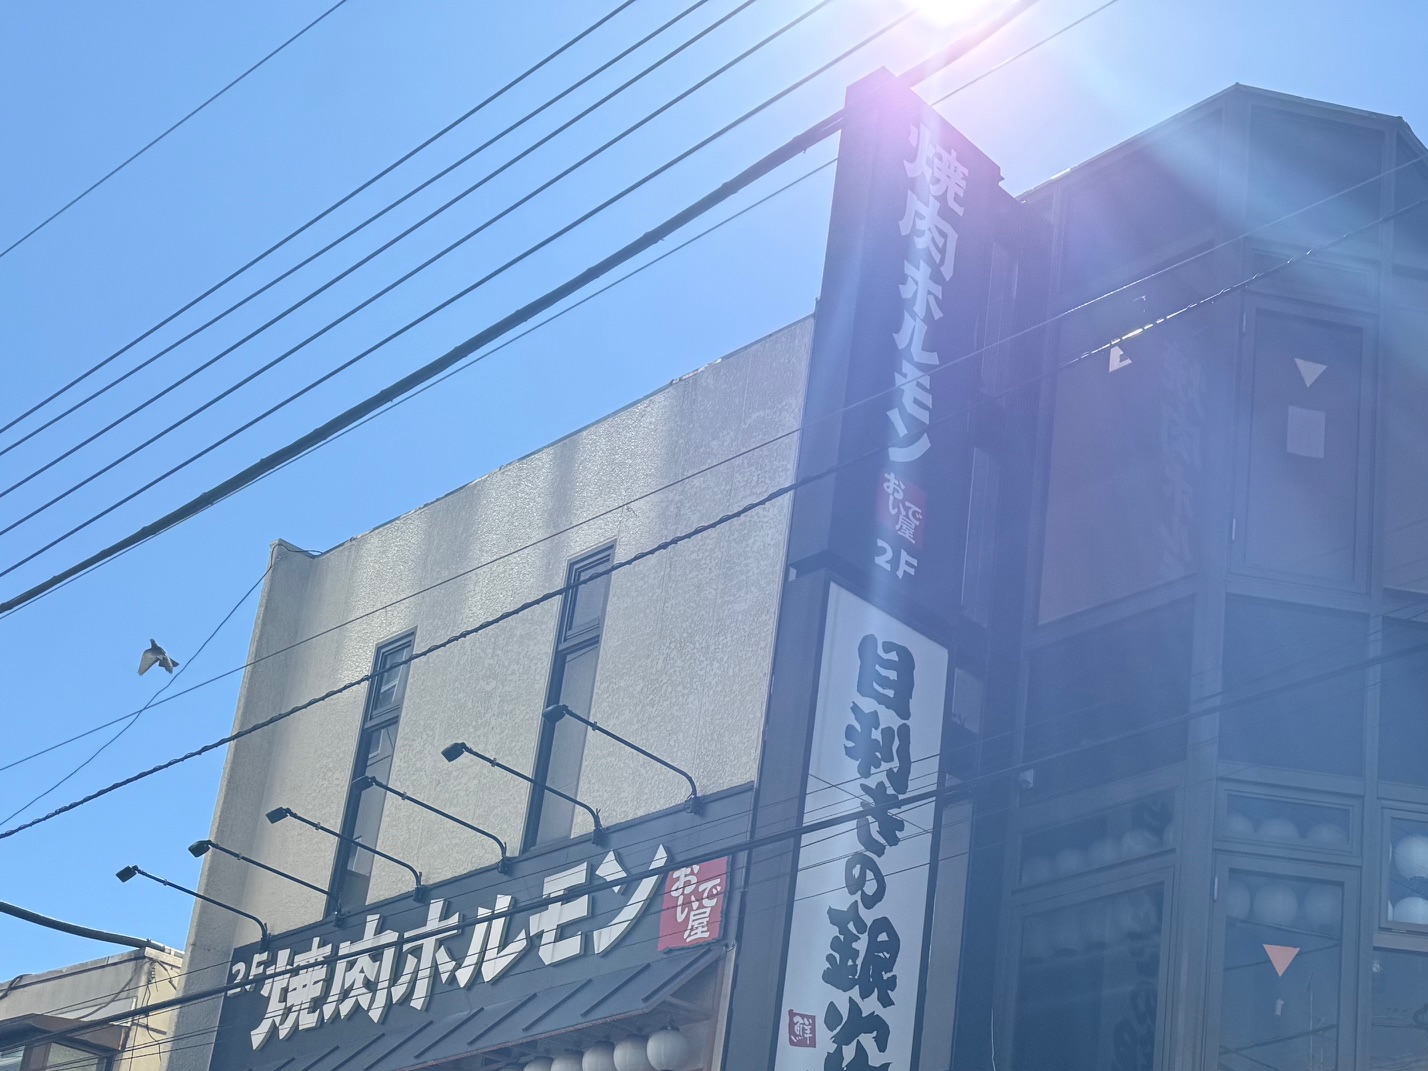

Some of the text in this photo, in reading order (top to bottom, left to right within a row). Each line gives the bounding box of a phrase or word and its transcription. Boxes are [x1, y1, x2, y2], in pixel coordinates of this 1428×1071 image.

[886, 122, 970, 463] 焼肉ホルモン
[882, 472, 923, 545] おいで屋
[874, 539, 917, 579] 2F
[671, 865, 723, 942] おいで屋
[227, 844, 668, 1051] 2F 焼肉ホルモン
[790, 1016, 813, 1045] 鮮
